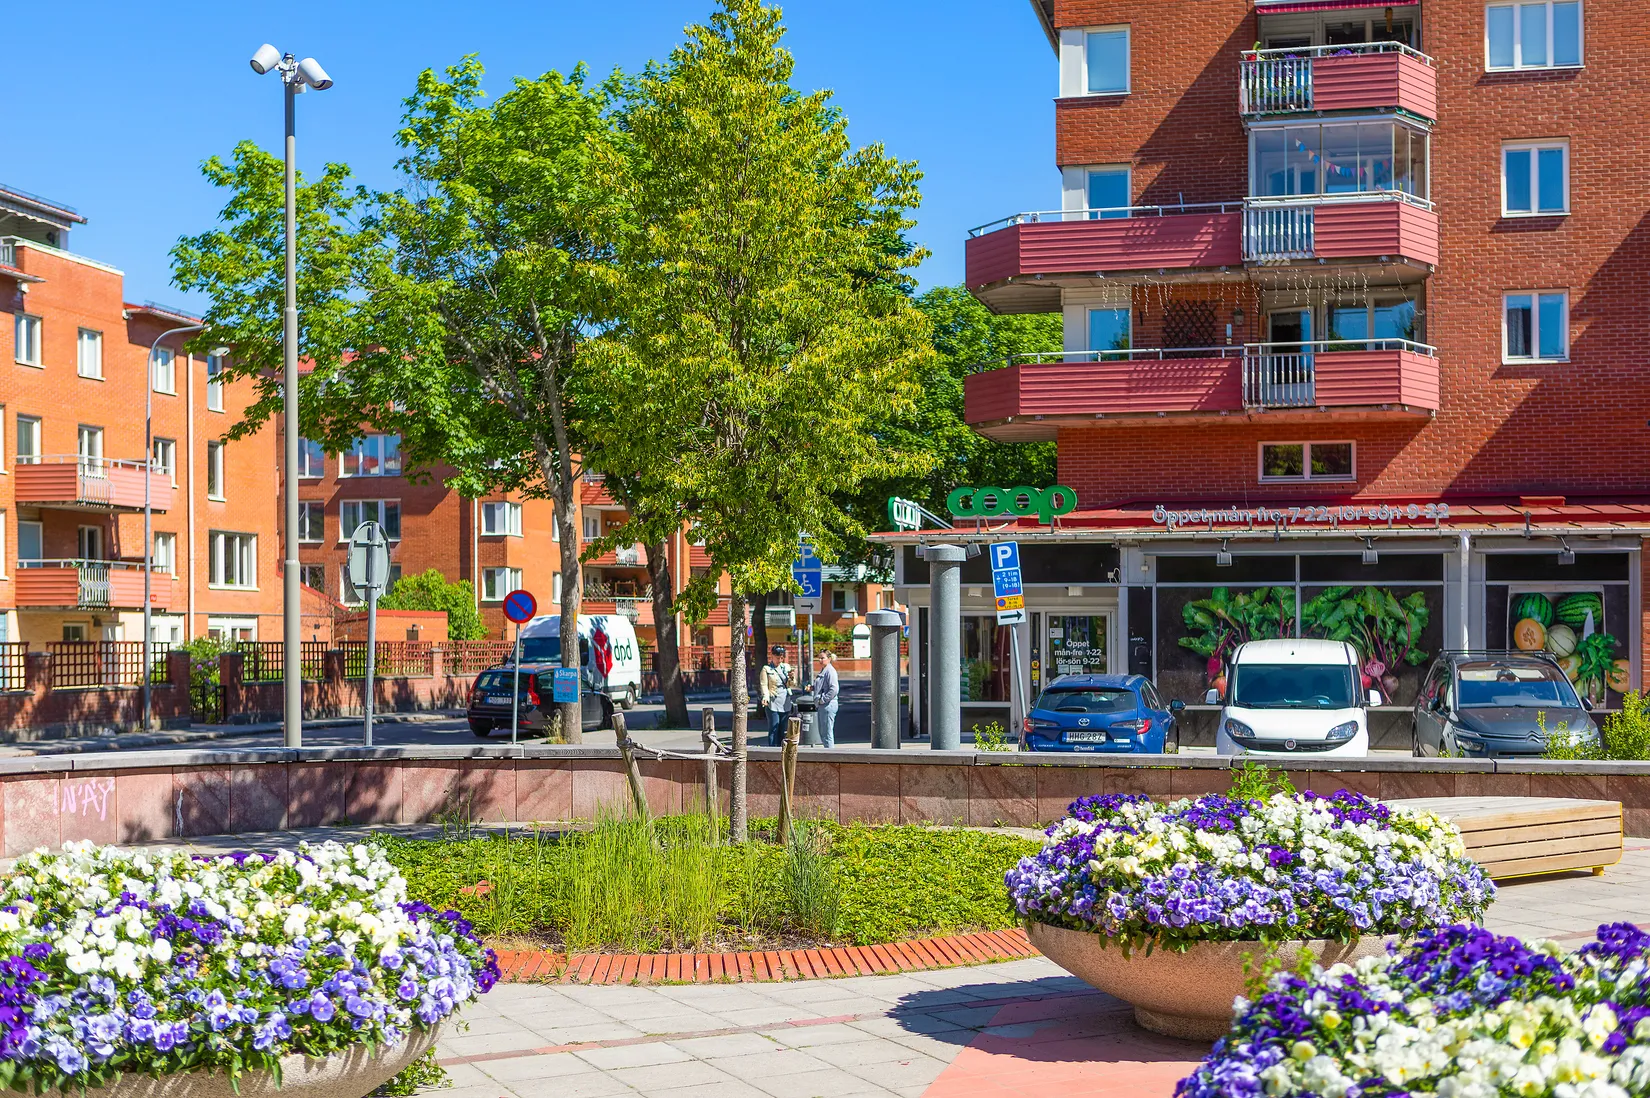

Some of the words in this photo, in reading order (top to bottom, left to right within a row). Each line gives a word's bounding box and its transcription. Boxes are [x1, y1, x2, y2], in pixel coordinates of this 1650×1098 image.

[947, 485, 1078, 524] coop
[1152, 504, 1209, 526] Öppet
[801, 545, 814, 567] P
[996, 546, 1012, 567] P
[614, 638, 632, 666] dpd
[1066, 639, 1090, 648] Öppet
[559, 670, 577, 678] Skarpa
